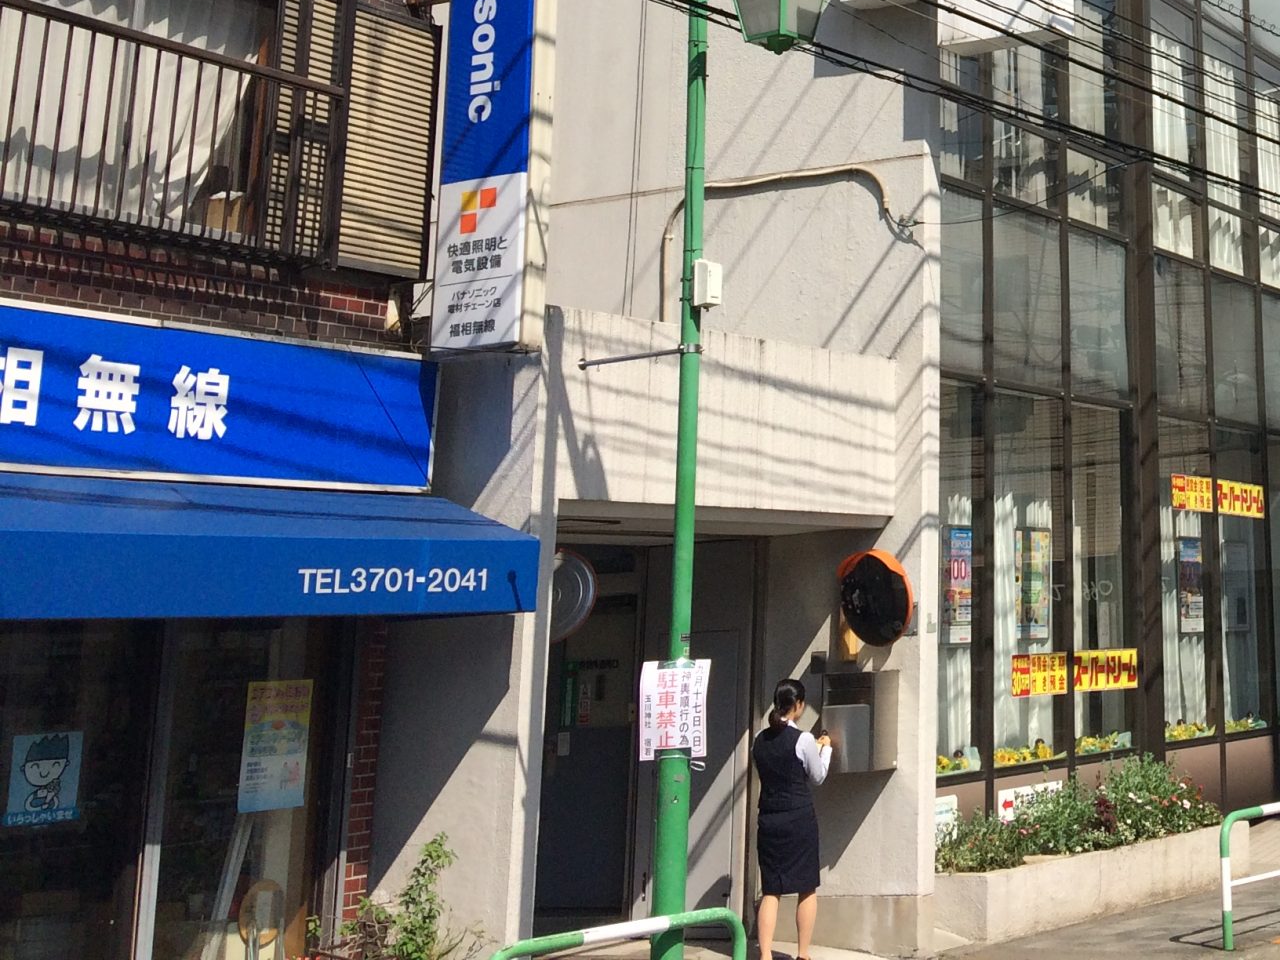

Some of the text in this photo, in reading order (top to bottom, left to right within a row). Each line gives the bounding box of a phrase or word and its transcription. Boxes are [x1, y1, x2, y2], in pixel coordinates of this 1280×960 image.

[447, 236, 508, 258] 快適照明と
[451, 254, 502, 274] 電気設備
[452, 286, 497, 301] パナソニック
[447, 297, 502, 314] 電材チェーン店
[449, 319, 496, 337] 福相無線
[298, 567, 488, 594] TEL3701-2041
[1074, 653, 1137, 687] スーパードリーム
[656, 670, 678, 748] 駐車禁止
